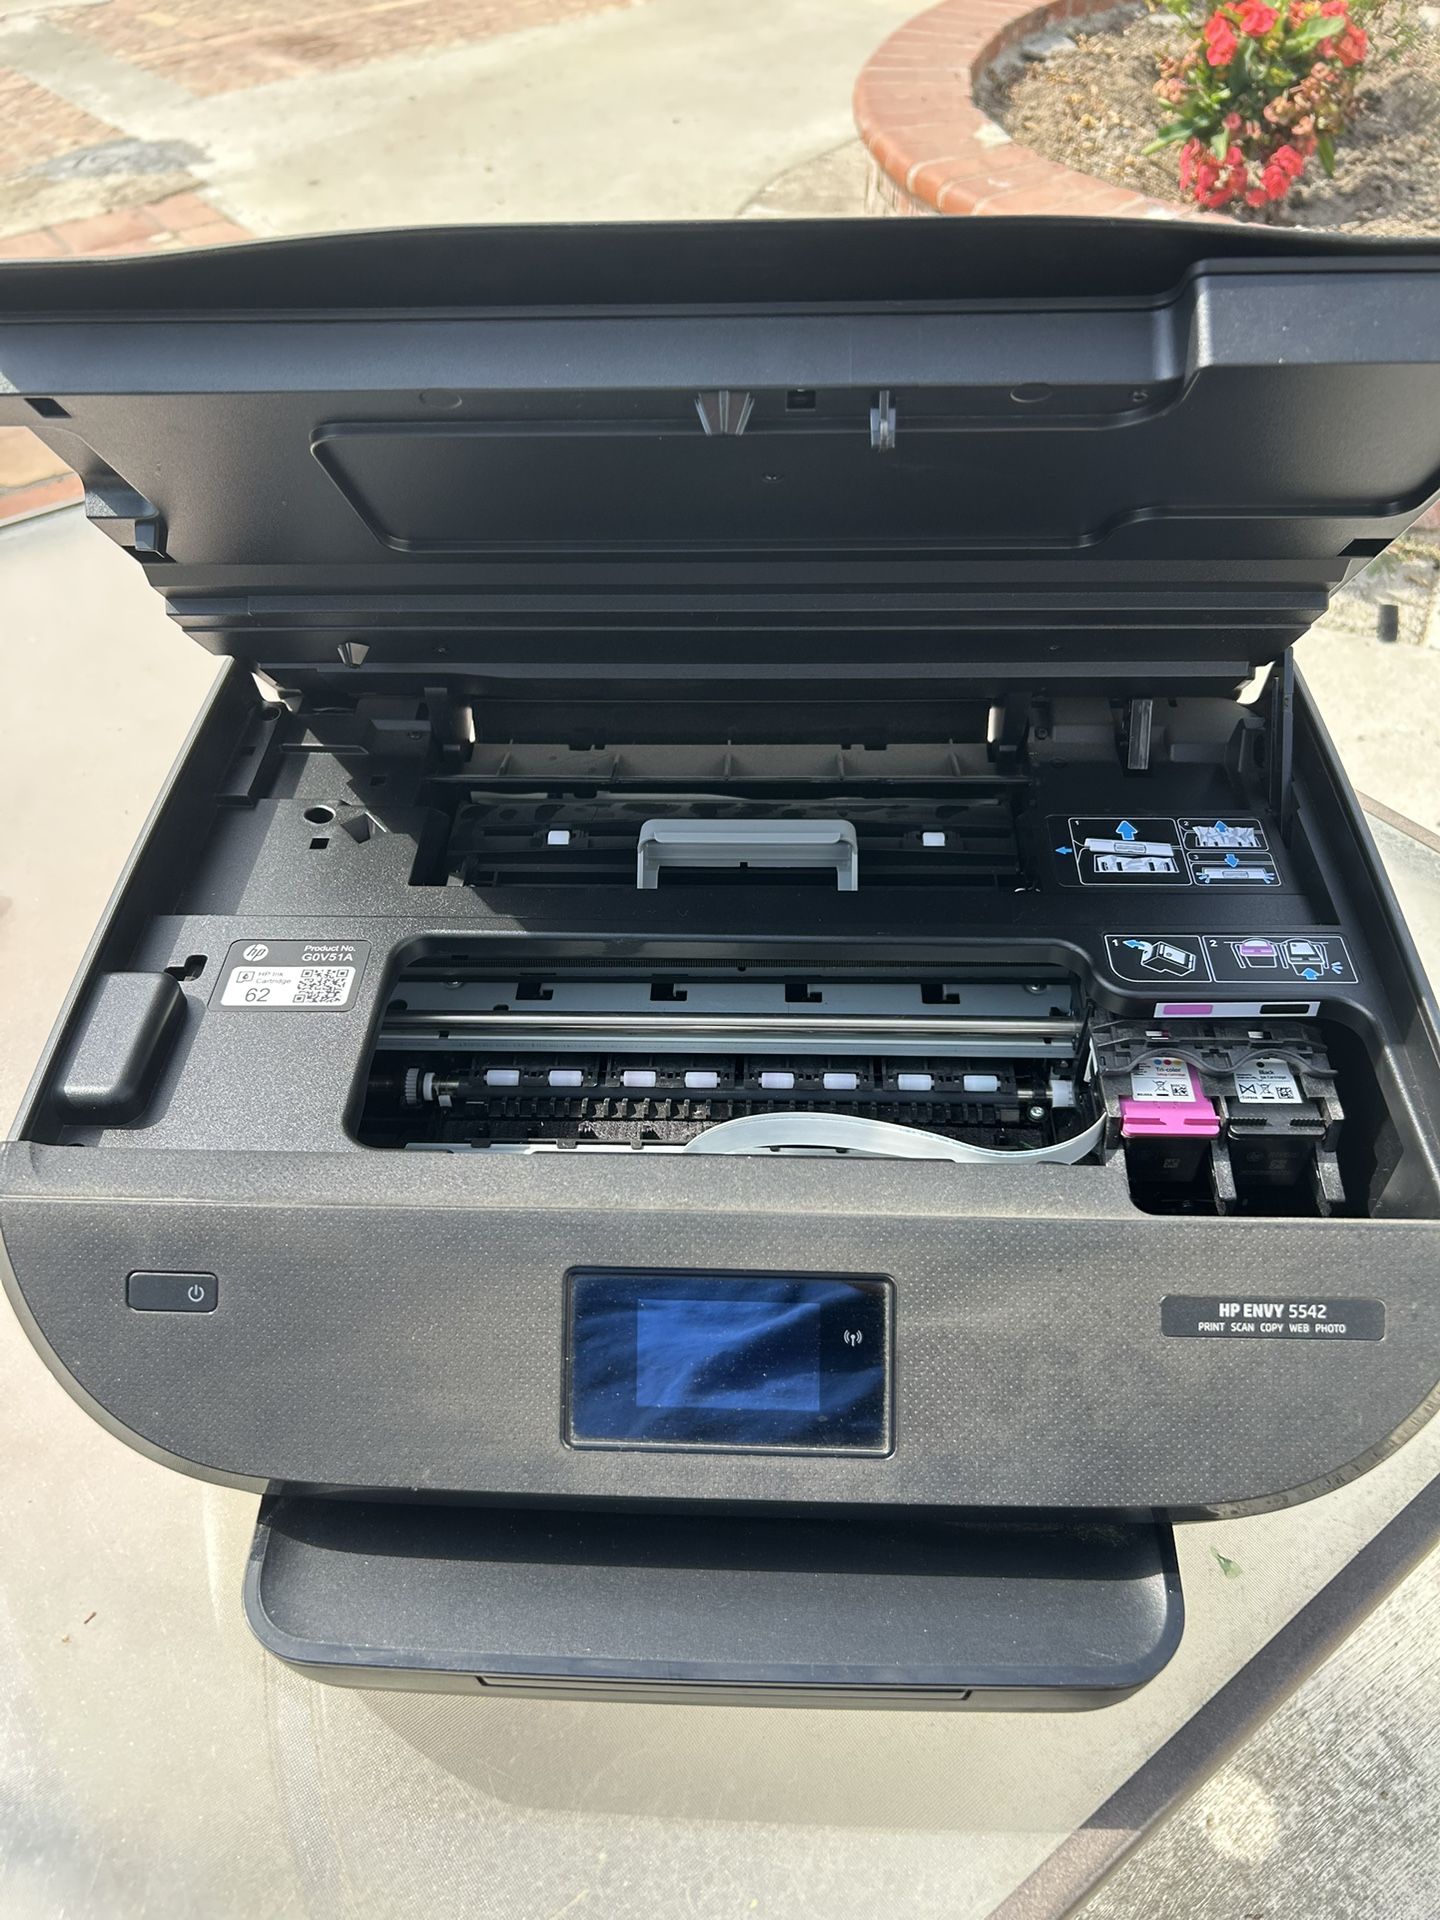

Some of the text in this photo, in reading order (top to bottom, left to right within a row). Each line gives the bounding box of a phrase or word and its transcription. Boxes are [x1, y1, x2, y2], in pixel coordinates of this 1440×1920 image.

[303, 944, 340, 952] Product
[1112, 939, 1119, 947] 1
[243, 943, 269, 961] hp
[245, 987, 271, 1002] 62
[1219, 1303, 1328, 1319] HP ENVY 5542
[1198, 1322, 1347, 1334] PRINT SCAN COPY WEB PHOTO
